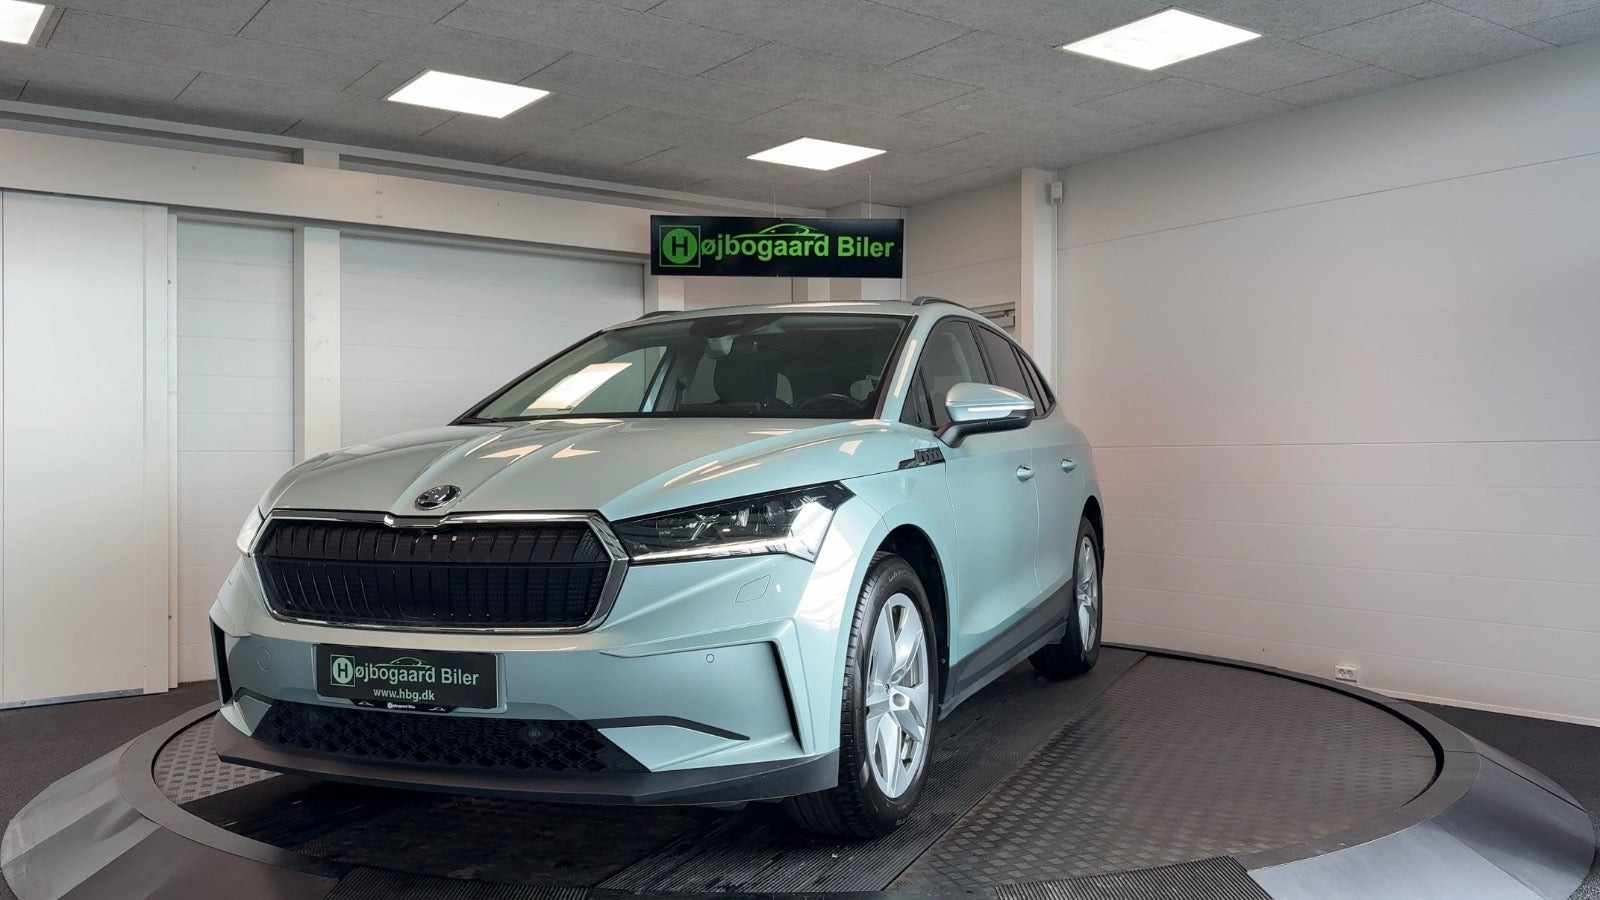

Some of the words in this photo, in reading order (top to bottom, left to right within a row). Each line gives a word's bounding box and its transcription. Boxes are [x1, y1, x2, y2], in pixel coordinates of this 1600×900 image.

[668, 231, 829, 262] Højbogaard
[838, 236, 895, 257] Biler
[335, 659, 436, 684] Højbogaard
[441, 668, 480, 686] Biler
[373, 688, 435, 702] www.hbg.dk
